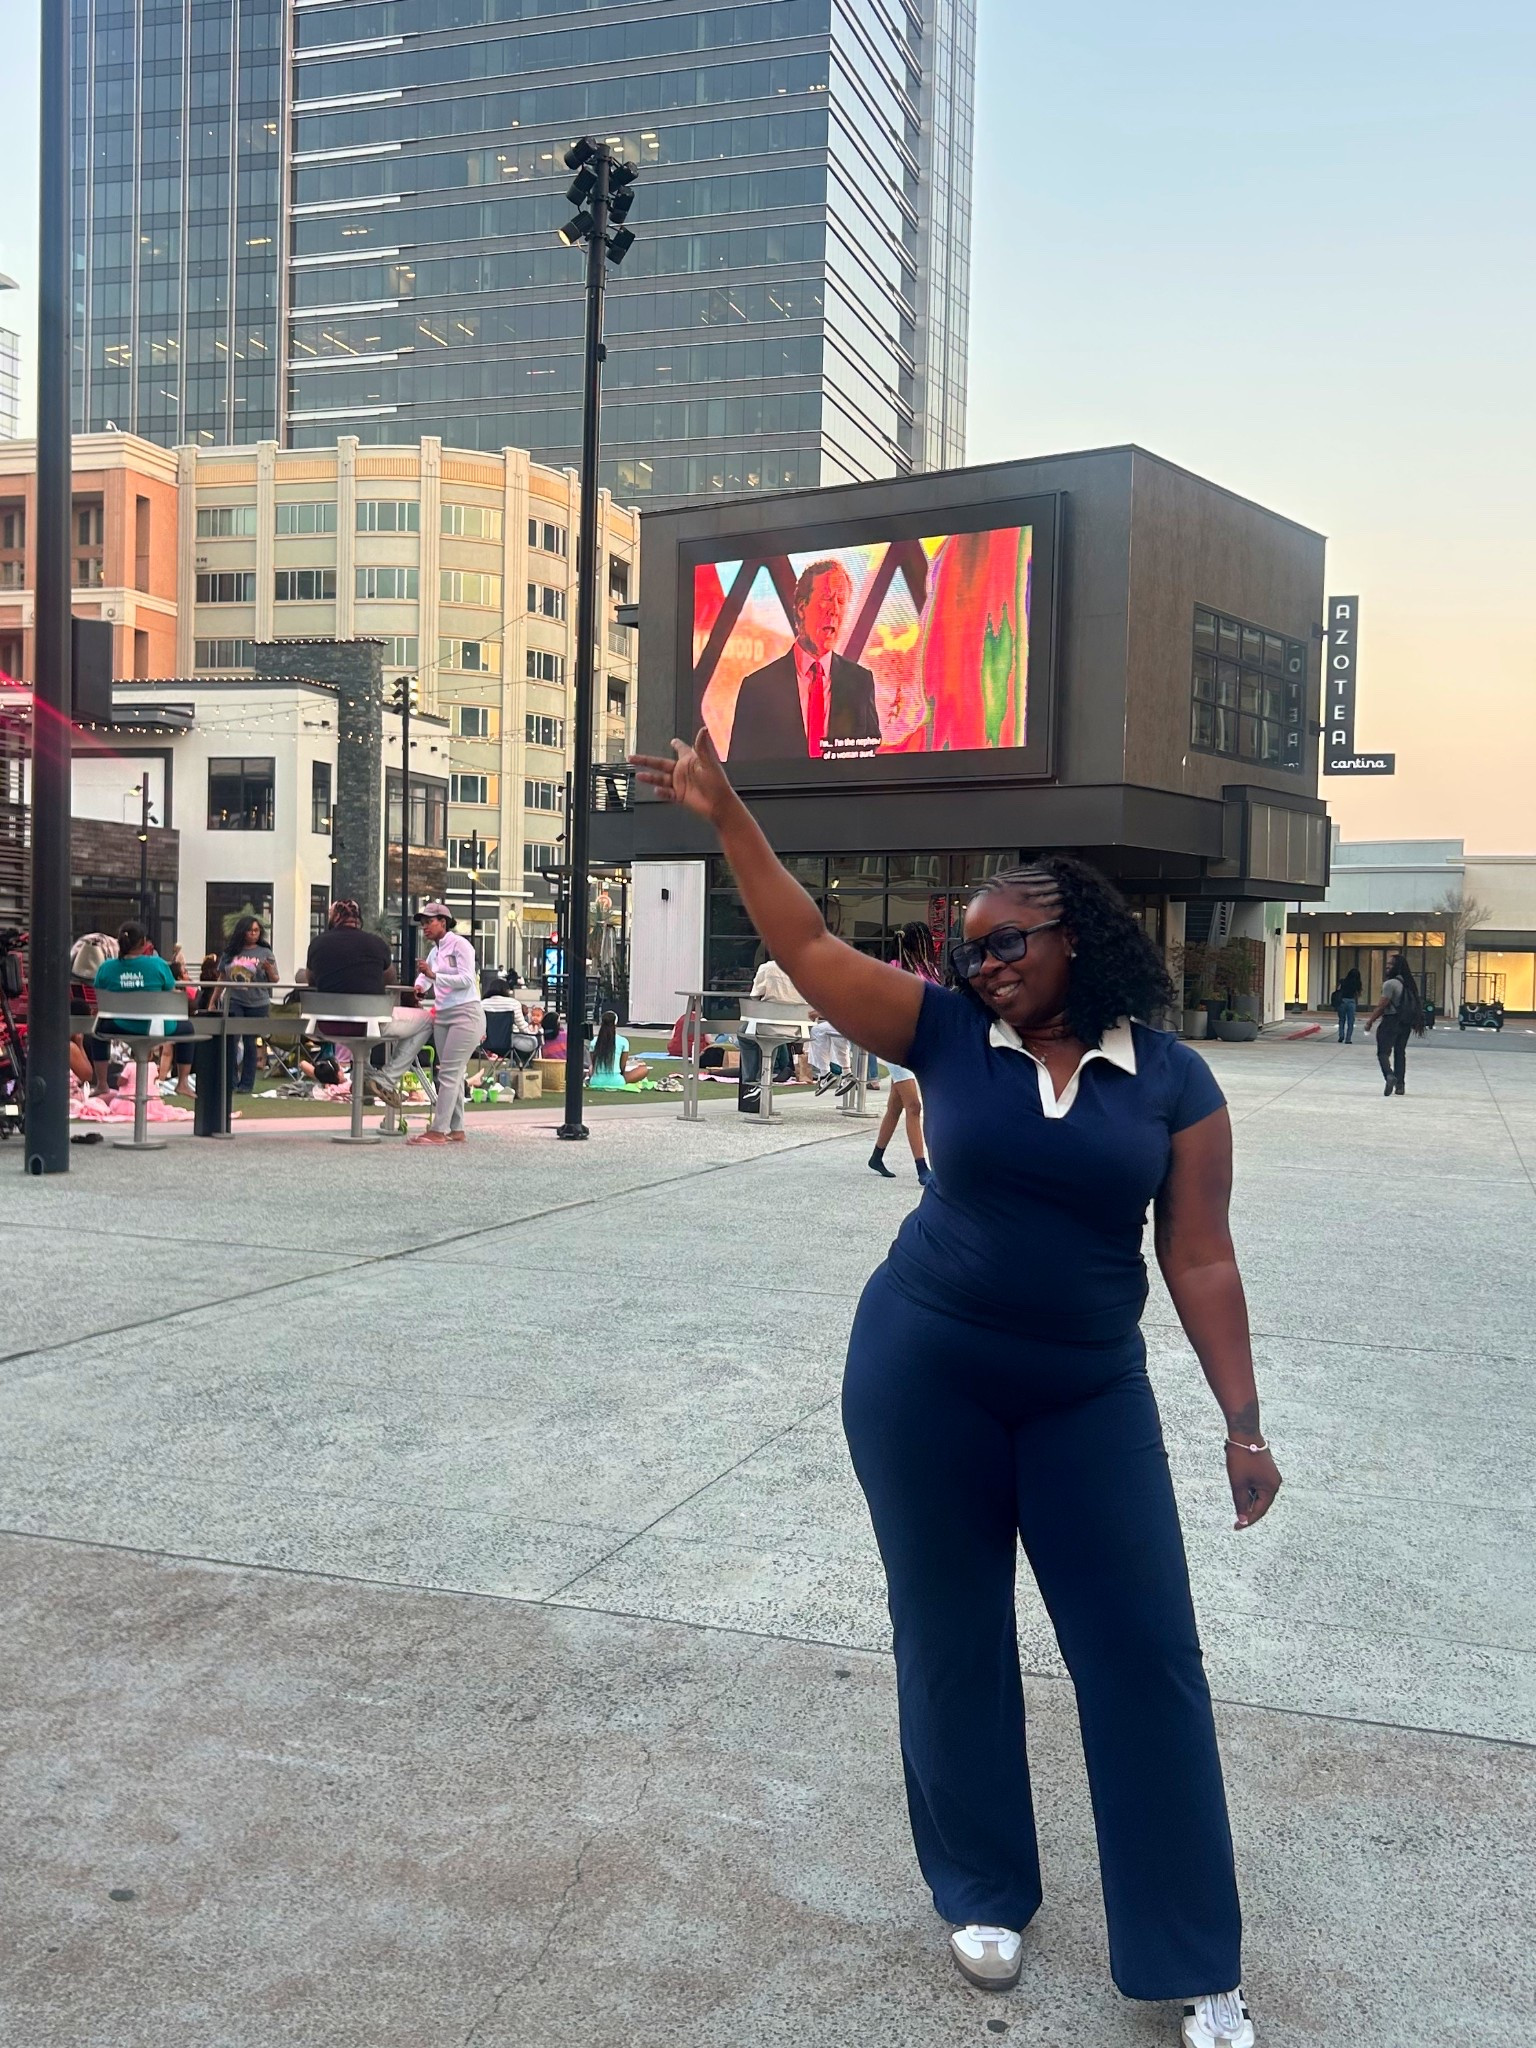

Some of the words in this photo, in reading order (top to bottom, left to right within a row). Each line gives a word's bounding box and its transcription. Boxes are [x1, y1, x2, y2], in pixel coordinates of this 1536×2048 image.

[1331, 604, 1350, 745] AZOTEA
[844, 737, 855, 746] the
[856, 736, 881, 747] nephew
[823, 750, 831, 760] of
[837, 751, 858, 759] woman
[1331, 757, 1387, 769] cantina
[1468, 1010, 1494, 1022] LOVE
